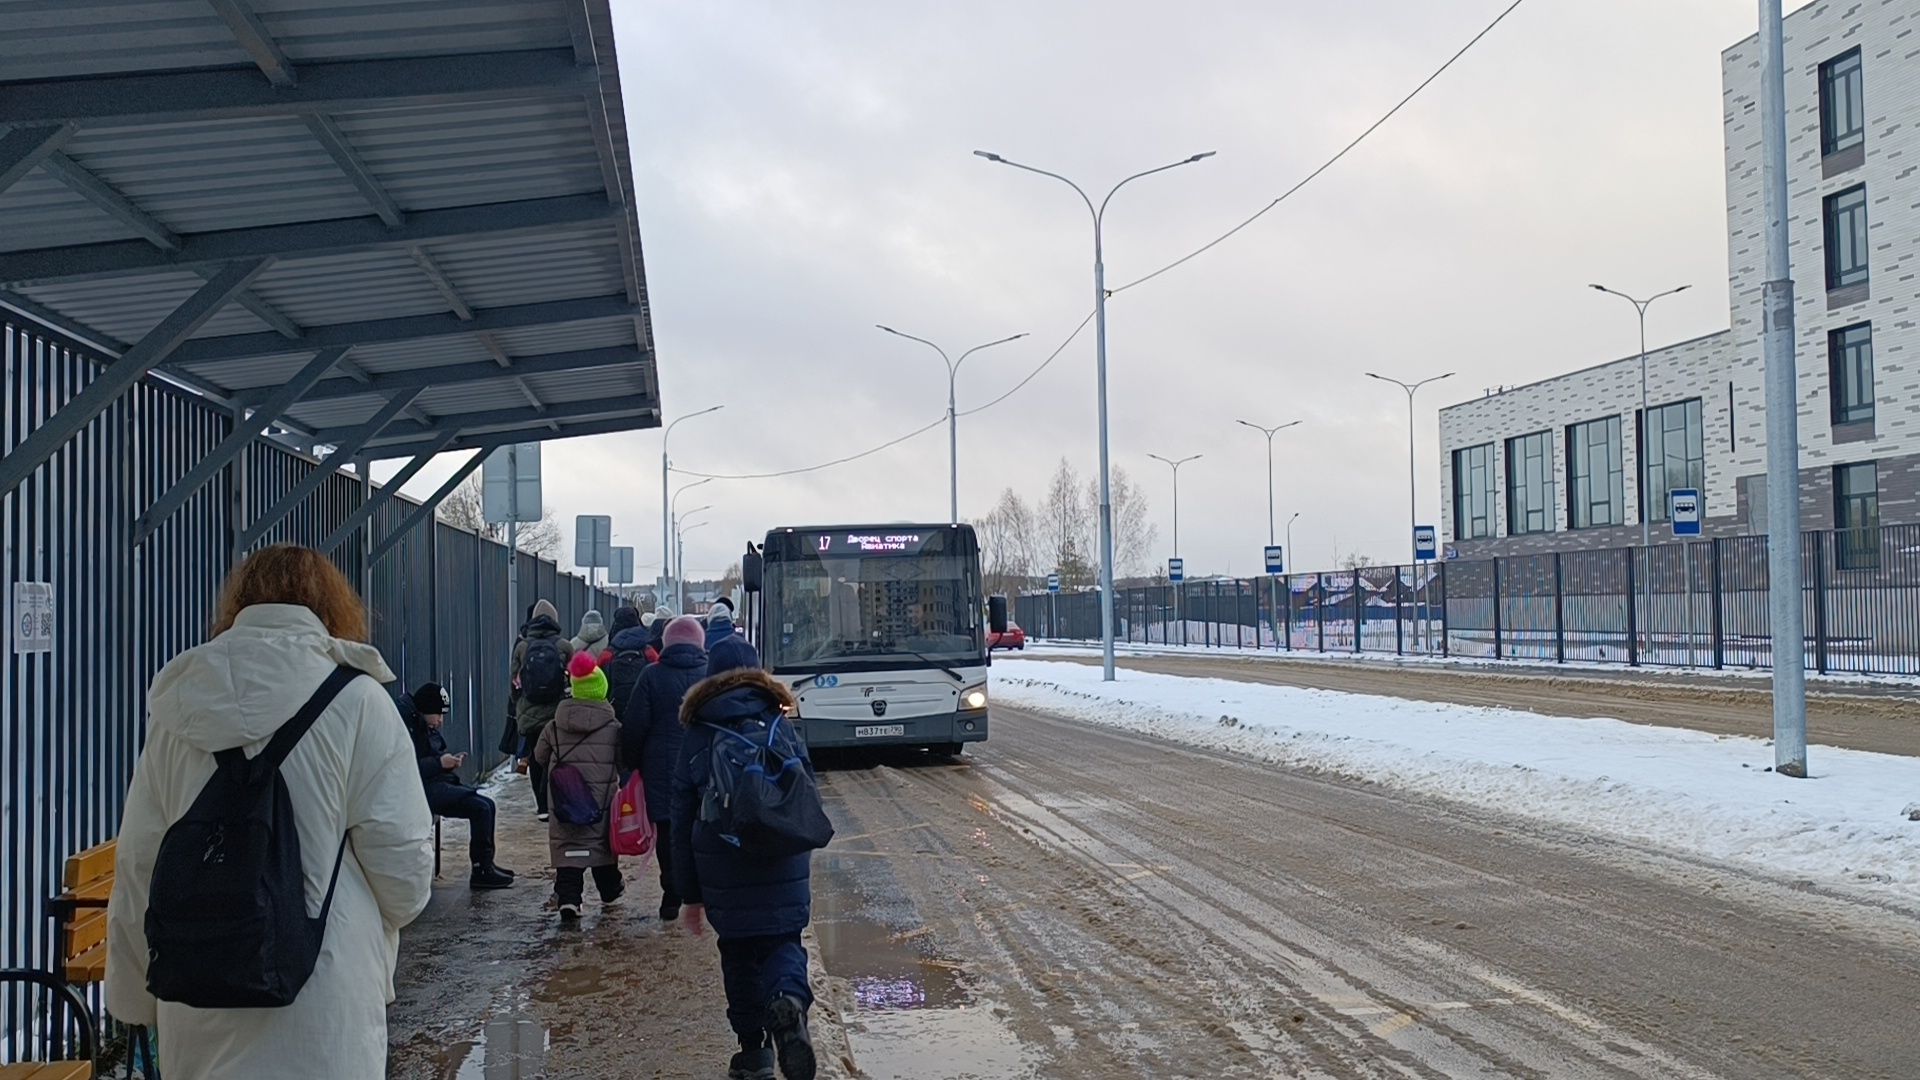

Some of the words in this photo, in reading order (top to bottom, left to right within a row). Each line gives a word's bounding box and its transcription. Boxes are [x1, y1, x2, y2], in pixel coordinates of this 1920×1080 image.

[819, 536, 831, 550] 17
[847, 535, 881, 544] Дворец
[885, 535, 919, 543] спорта
